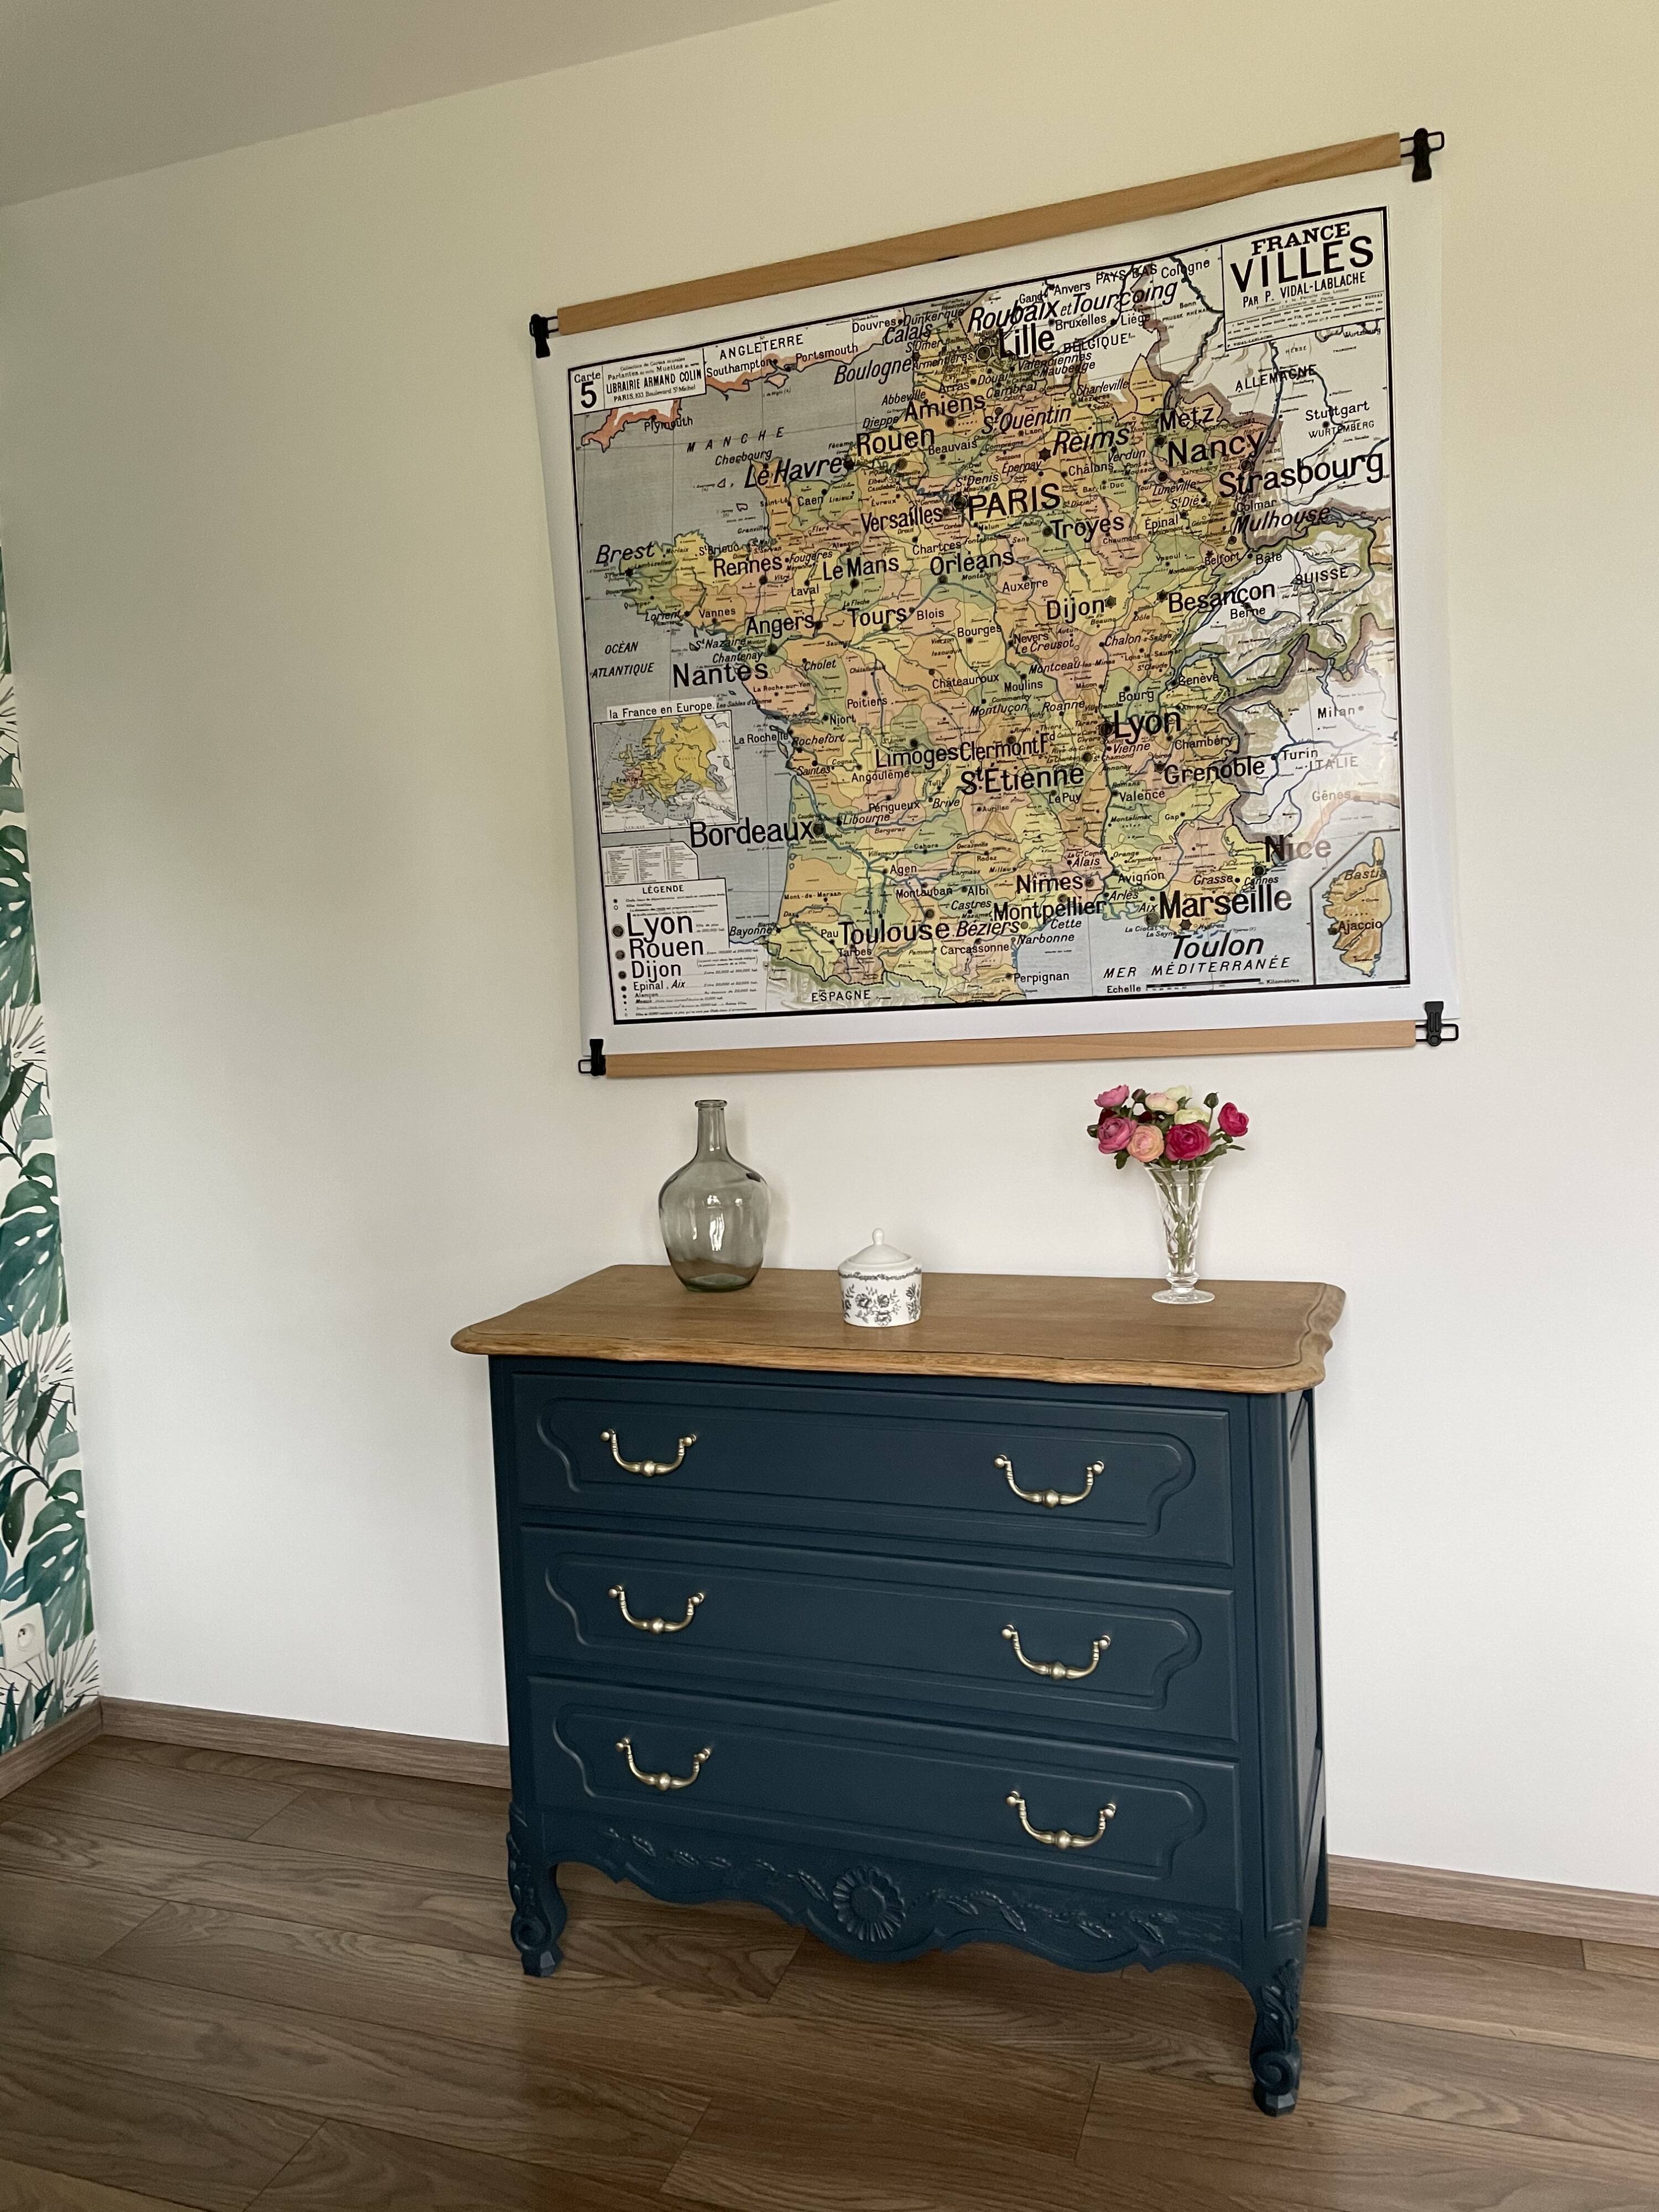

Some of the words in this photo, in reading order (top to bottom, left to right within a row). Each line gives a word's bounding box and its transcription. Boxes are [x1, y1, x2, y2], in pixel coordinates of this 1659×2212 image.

[1251, 222, 1350, 256] FRANCE
[1230, 236, 1374, 293] VILLES
[1053, 281, 1091, 296] Anvers
[1243, 295, 1258, 309] PAR
[1265, 290, 1274, 302] P.
[1280, 272, 1366, 299] VIDAL-LABLACHE
[967, 299, 1060, 333] Roubaix
[1061, 302, 1072, 317] et
[1073, 281, 1178, 315] Tourcoing
[852, 317, 896, 333] Douvres
[902, 307, 964, 327] Dunkerque
[1055, 314, 1107, 331] Bruxelles
[885, 324, 933, 346] Calais
[999, 322, 1055, 359] Lille
[719, 333, 804, 360] ANGLETERRE
[1063, 333, 1129, 355] BELGIQUE
[795, 343, 858, 363] Portsmouth
[608, 372, 639, 380] Parlantes
[706, 358, 771, 378] Southampton
[834, 358, 912, 385] Boulogne
[575, 371, 601, 383] Carte
[607, 379, 640, 394] LIBRAIRIE
[644, 373, 676, 388] ARMAND
[680, 368, 702, 382] COLIN
[1235, 364, 1318, 392] ALLEMAGNE
[581, 382, 597, 408] 5
[1077, 377, 1130, 397] Charleville
[881, 389, 926, 406] Abbeville
[905, 394, 986, 422] Amiens
[1305, 400, 1370, 421] Stuttgart
[644, 416, 693, 434] Plymouth
[863, 415, 900, 429] Dieppe
[1161, 406, 1214, 431] Metz
[1308, 420, 1375, 439] WURTEMBERG
[686, 427, 785, 452] MANCHE
[857, 428, 935, 456] Rouen
[928, 440, 978, 456] Beauvais
[1052, 428, 1130, 456] Reims
[716, 449, 773, 466] Cherbourg
[1107, 449, 1146, 463] Verdun
[1168, 431, 1264, 468] Nancy
[744, 463, 769, 488] Le
[774, 456, 843, 484] Havre
[1001, 460, 1042, 477] Épernay
[1219, 452, 1383, 498] Strasbourg
[798, 495, 823, 507] Caen
[968, 483, 1061, 521] PARIS
[860, 506, 943, 533] Versailles
[1233, 506, 1331, 535] Mulhouse
[1049, 515, 1125, 543] Troyes
[595, 541, 655, 565] Brest
[912, 541, 962, 556] Chartres
[713, 555, 783, 576] Rennes
[930, 550, 1015, 576] Orléans
[1205, 553, 1240, 566] Belfort
[823, 561, 843, 581] Le
[847, 556, 900, 578] Mans
[1295, 567, 1349, 585] SUISSE
[791, 583, 820, 597] Laval
[1002, 578, 1049, 593] Auxerre
[1168, 583, 1276, 614] Besançon
[698, 607, 736, 618] Vannes
[847, 607, 908, 628] Tours
[916, 608, 945, 621] Blois
[1046, 596, 1105, 624] Dijon
[1230, 607, 1266, 620] Berne
[746, 613, 816, 639] Angers
[957, 623, 1002, 638] Bourges
[604, 640, 639, 654] OCÉAN
[712, 650, 763, 665] Chantenay
[804, 658, 837, 671] Cholet
[592, 662, 655, 679] ATLANTIQUE
[673, 662, 768, 688] Nantes
[932, 674, 999, 690] Châteauroux
[1004, 680, 1044, 692] Moulins
[1178, 672, 1219, 687] Genève
[847, 697, 888, 709] Poitiers
[1119, 691, 1155, 703] Bourg
[610, 709, 619, 719] la
[623, 707, 657, 718] France
[661, 705, 673, 714] en
[969, 703, 1028, 717] Montluçon
[1042, 700, 1086, 713] Roanne
[1318, 706, 1355, 719] Milan
[1114, 709, 1182, 745] Lyon
[793, 734, 846, 747] Rochefort
[1113, 742, 1151, 755] Vienne
[1175, 735, 1234, 751] Chambéry
[876, 746, 959, 770] Limoges
[1281, 748, 1318, 761] Turin
[852, 769, 910, 784] Angoulême
[1164, 756, 1265, 785] Grenoble
[1119, 790, 1165, 803] Valence
[1312, 790, 1351, 802] Gênes
[869, 801, 921, 814] Périgueux
[690, 816, 815, 849] Bordeaux
[1265, 834, 1332, 863] Nice
[890, 864, 917, 877] Agen
[1118, 871, 1165, 886] Avignon
[1343, 869, 1388, 881] Bastia
[1016, 873, 1084, 895] Nîmes
[1193, 874, 1234, 886] Grasse
[642, 884, 685, 895] LÉGENDE
[895, 886, 953, 900] Montauban
[968, 884, 989, 896] Albi
[951, 900, 992, 911] Castres
[993, 895, 1107, 924] Montpellier
[1160, 884, 1293, 920] Marseille
[627, 912, 693, 943] Lyon
[729, 926, 773, 940] Bayonne
[821, 928, 839, 938] Pau
[837, 919, 950, 946] Toulouse
[1051, 919, 1082, 930] Cette
[1338, 919, 1383, 935] Ajaccio
[629, 937, 704, 959] Rouen
[940, 942, 1010, 956] Carcassonne
[1172, 931, 1264, 959] Toulon
[631, 959, 682, 983] Dijon
[1103, 967, 1137, 979] MER
[1151, 954, 1291, 976] MÉDITERRANÉE
[1014, 971, 1070, 985] Perpignan
[811, 989, 871, 1003] ESPAGNE
[1107, 984, 1141, 994] Echelle
